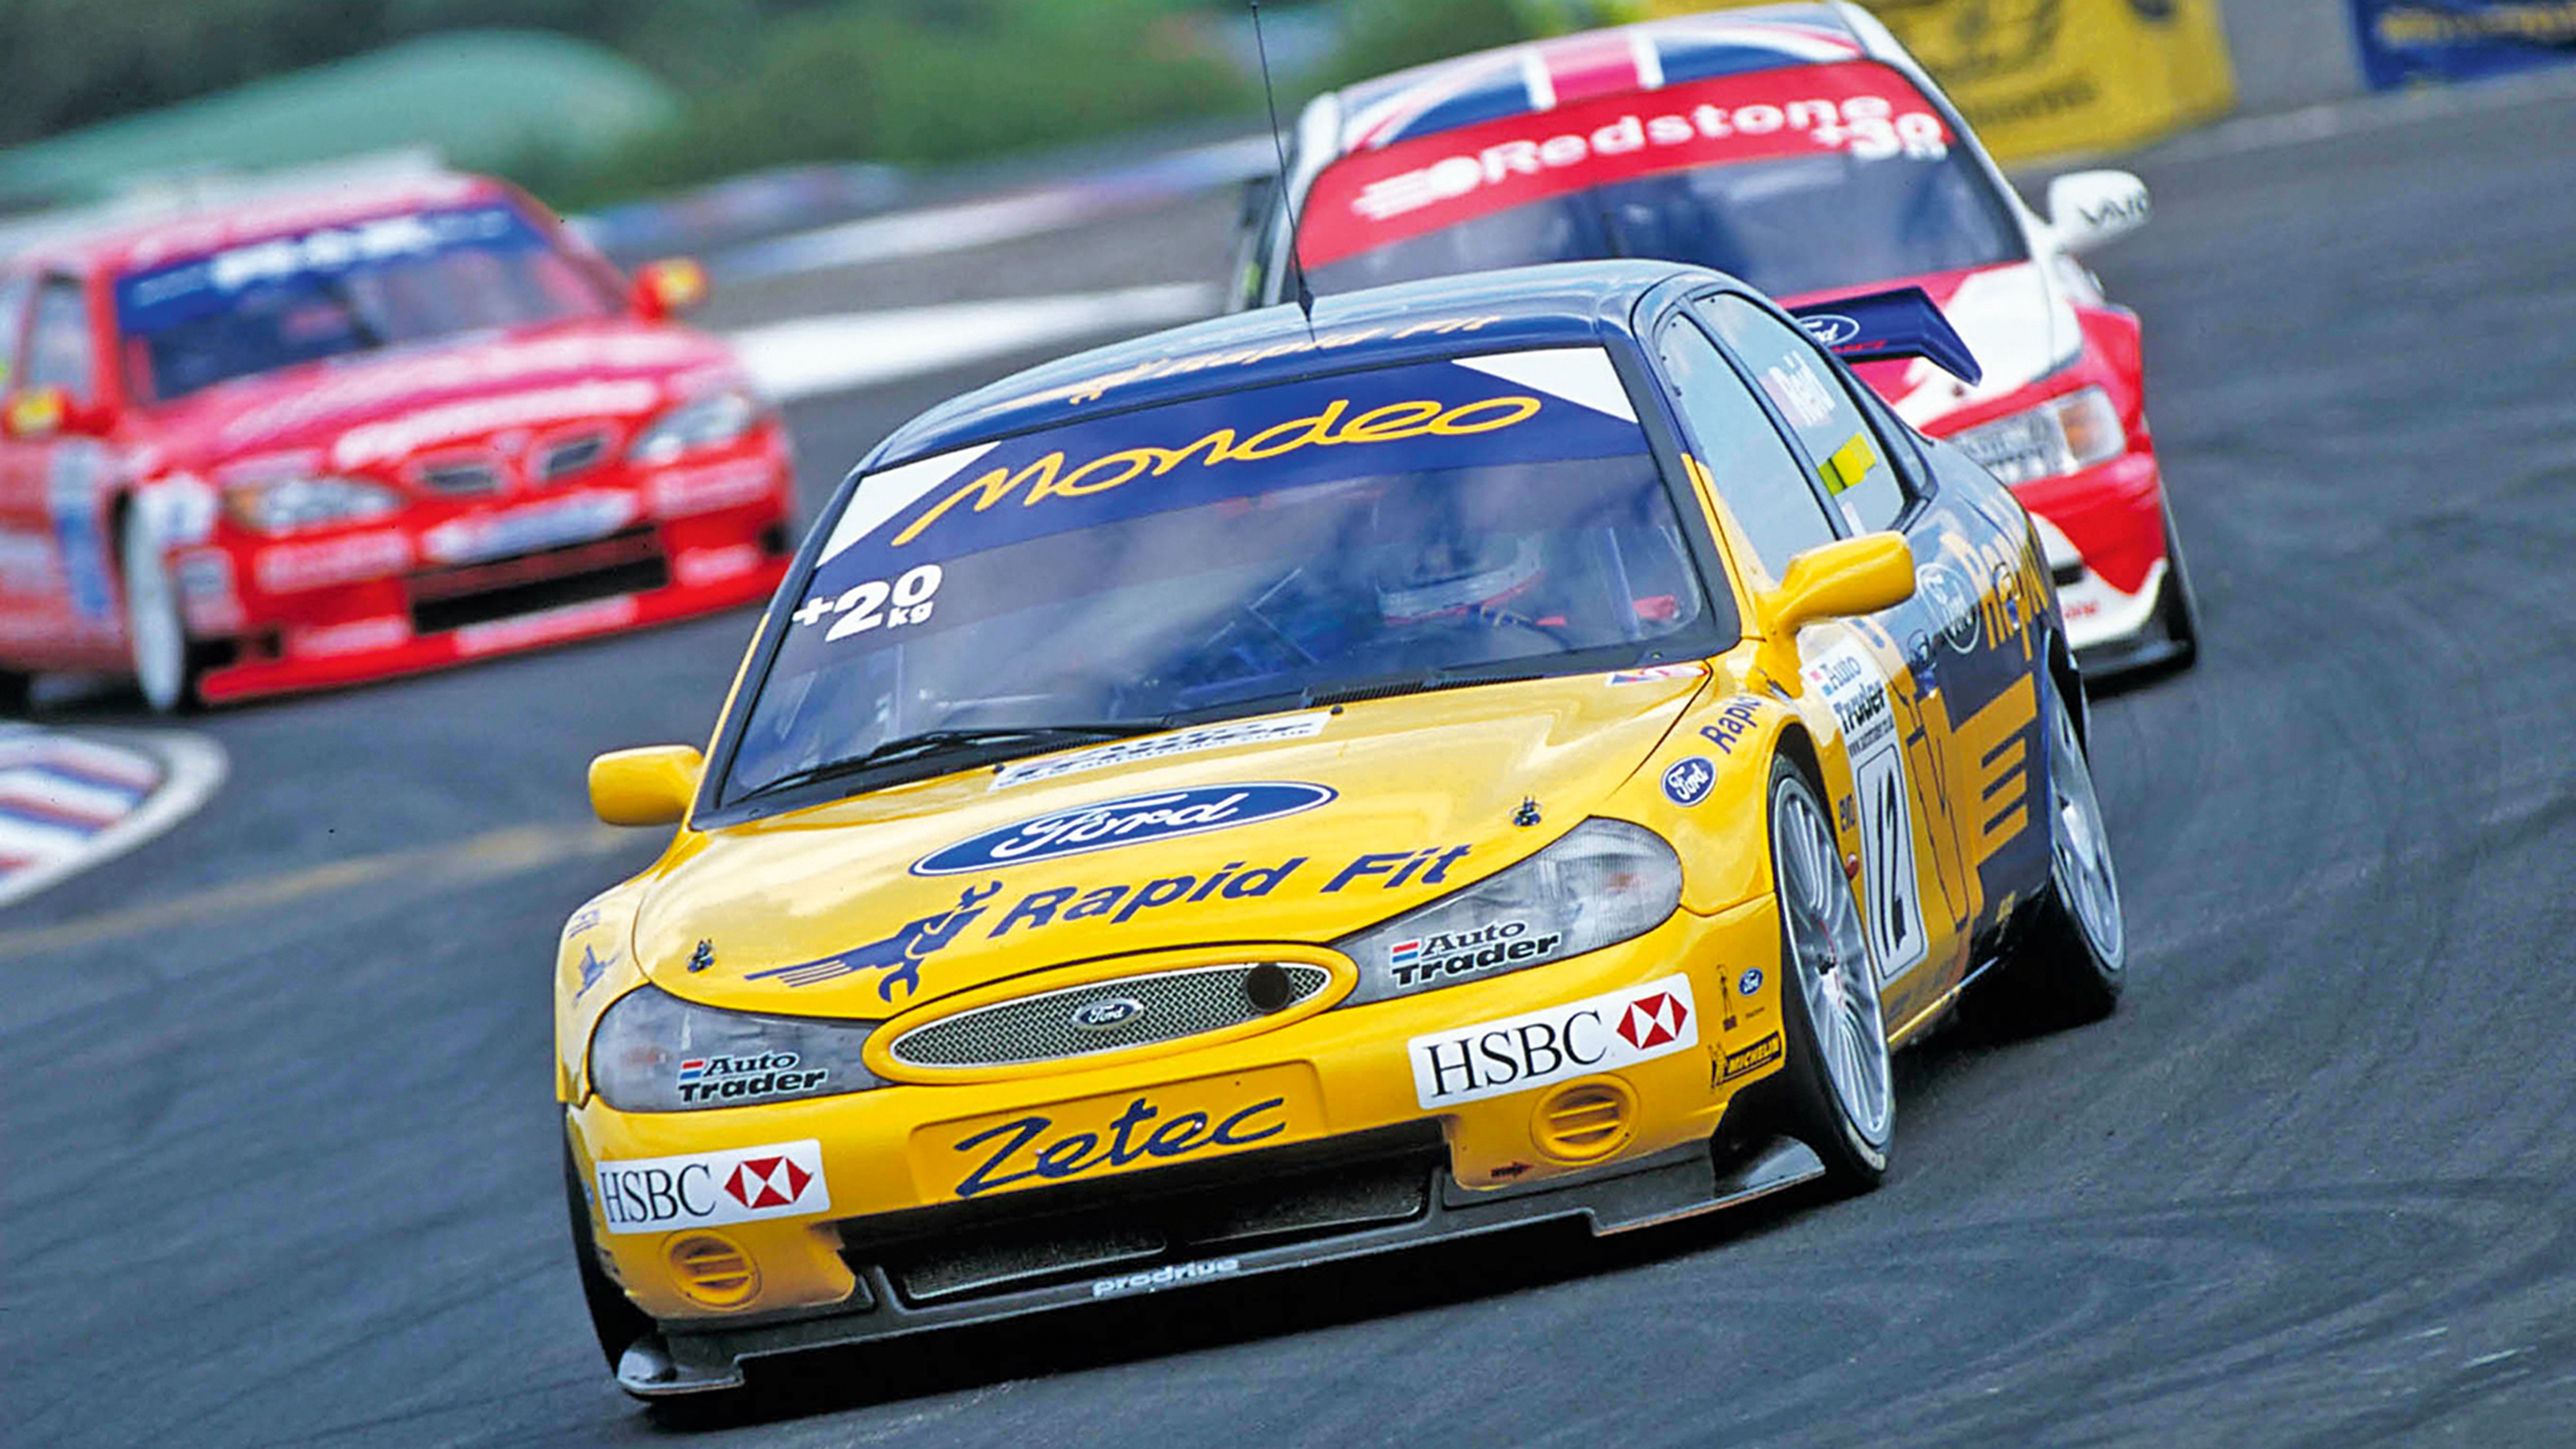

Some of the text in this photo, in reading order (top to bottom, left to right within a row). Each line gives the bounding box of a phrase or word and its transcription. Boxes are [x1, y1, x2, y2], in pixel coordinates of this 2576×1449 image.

[890, 395, 1542, 547] Mondeo
[792, 564, 943, 642] +20
[887, 601, 934, 630] kg
[1818, 655, 1862, 691] Auto
[1668, 762, 1709, 800] Ford
[990, 793, 1250, 859] Ford
[987, 844, 1472, 940] Rapid Fit
[1392, 934, 1559, 986] Trader
[1421, 922, 1527, 957] Auto
[703, 1051, 799, 1078] Auto
[1426, 1009, 1609, 1098] HSBC
[679, 1071, 827, 1102] Trader
[954, 1097, 1286, 1198] Zetec
[599, 1163, 716, 1223] HSBC
